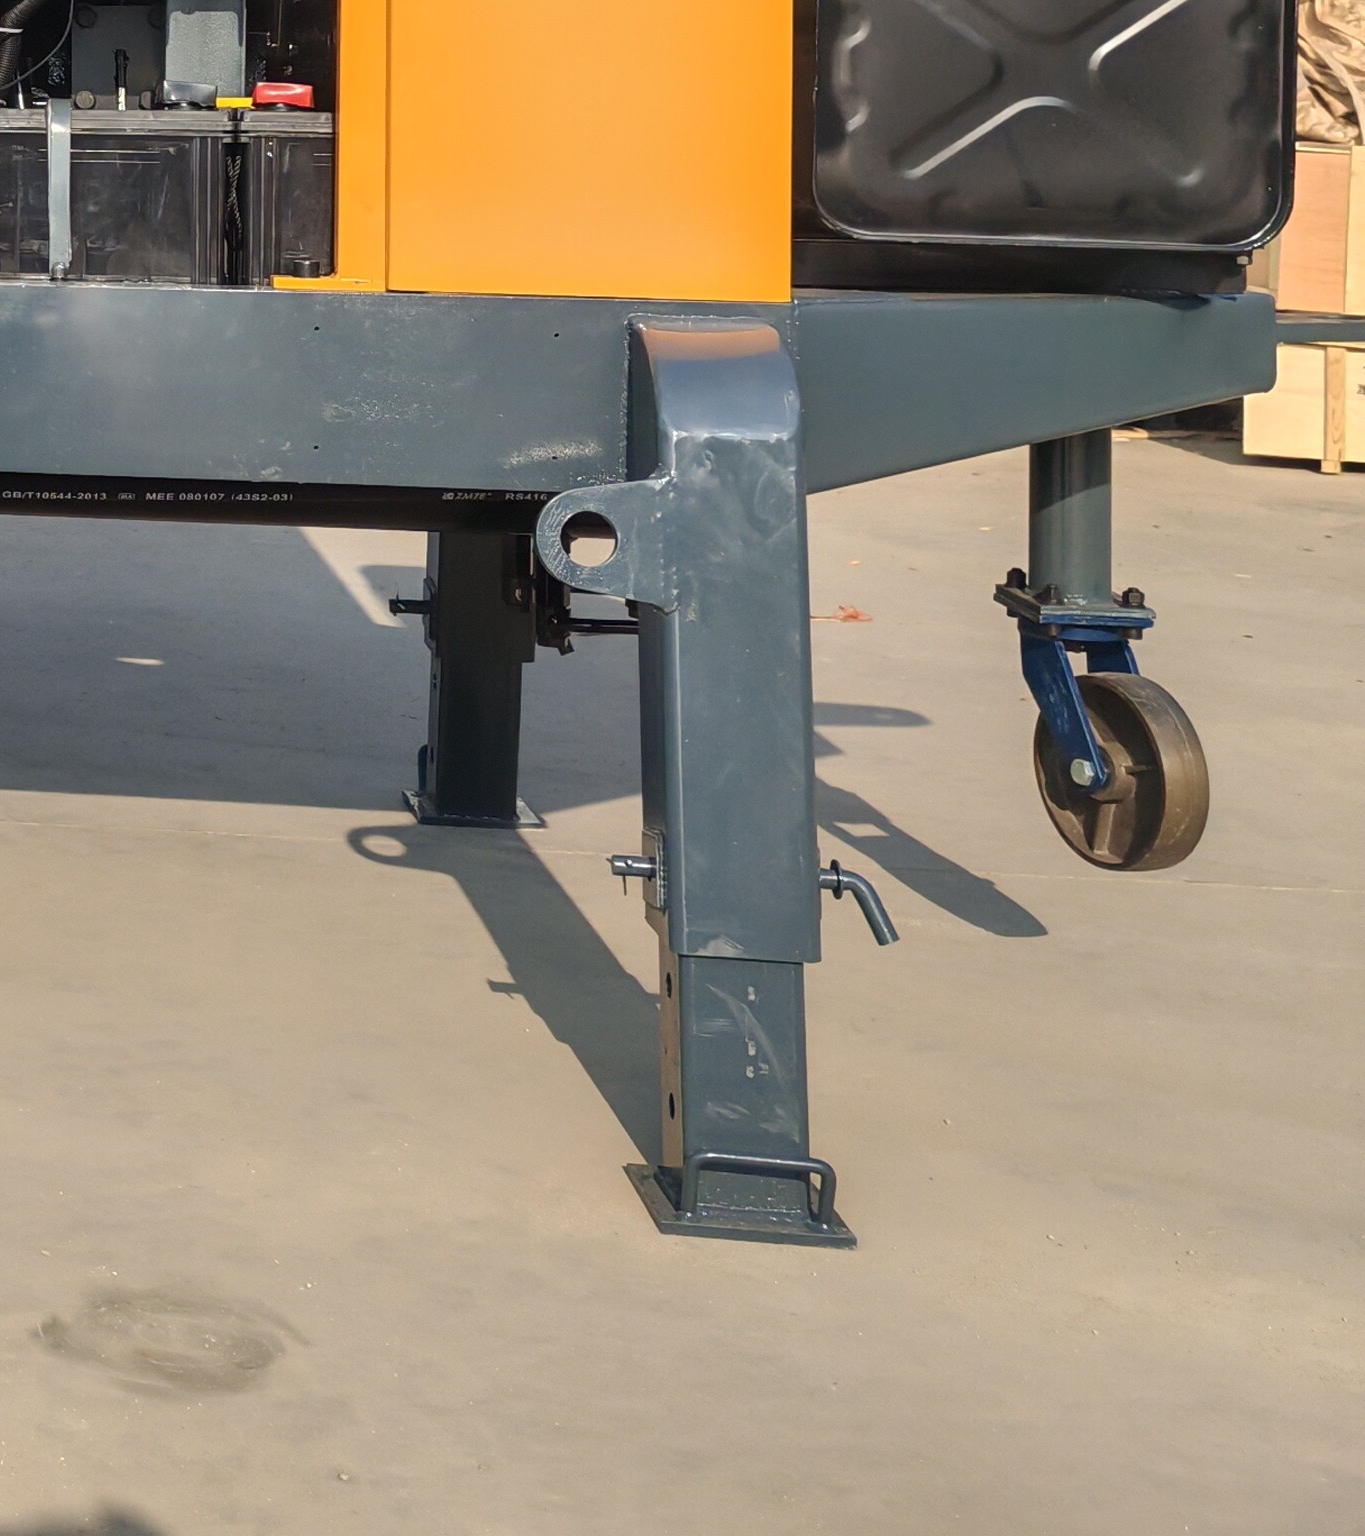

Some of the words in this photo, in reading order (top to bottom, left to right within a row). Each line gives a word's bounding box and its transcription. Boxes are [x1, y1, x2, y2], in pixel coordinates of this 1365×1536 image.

[2, 490, 107, 501] GB/T10544-2013
[146, 492, 174, 501] MEE
[179, 493, 224, 501] 080107
